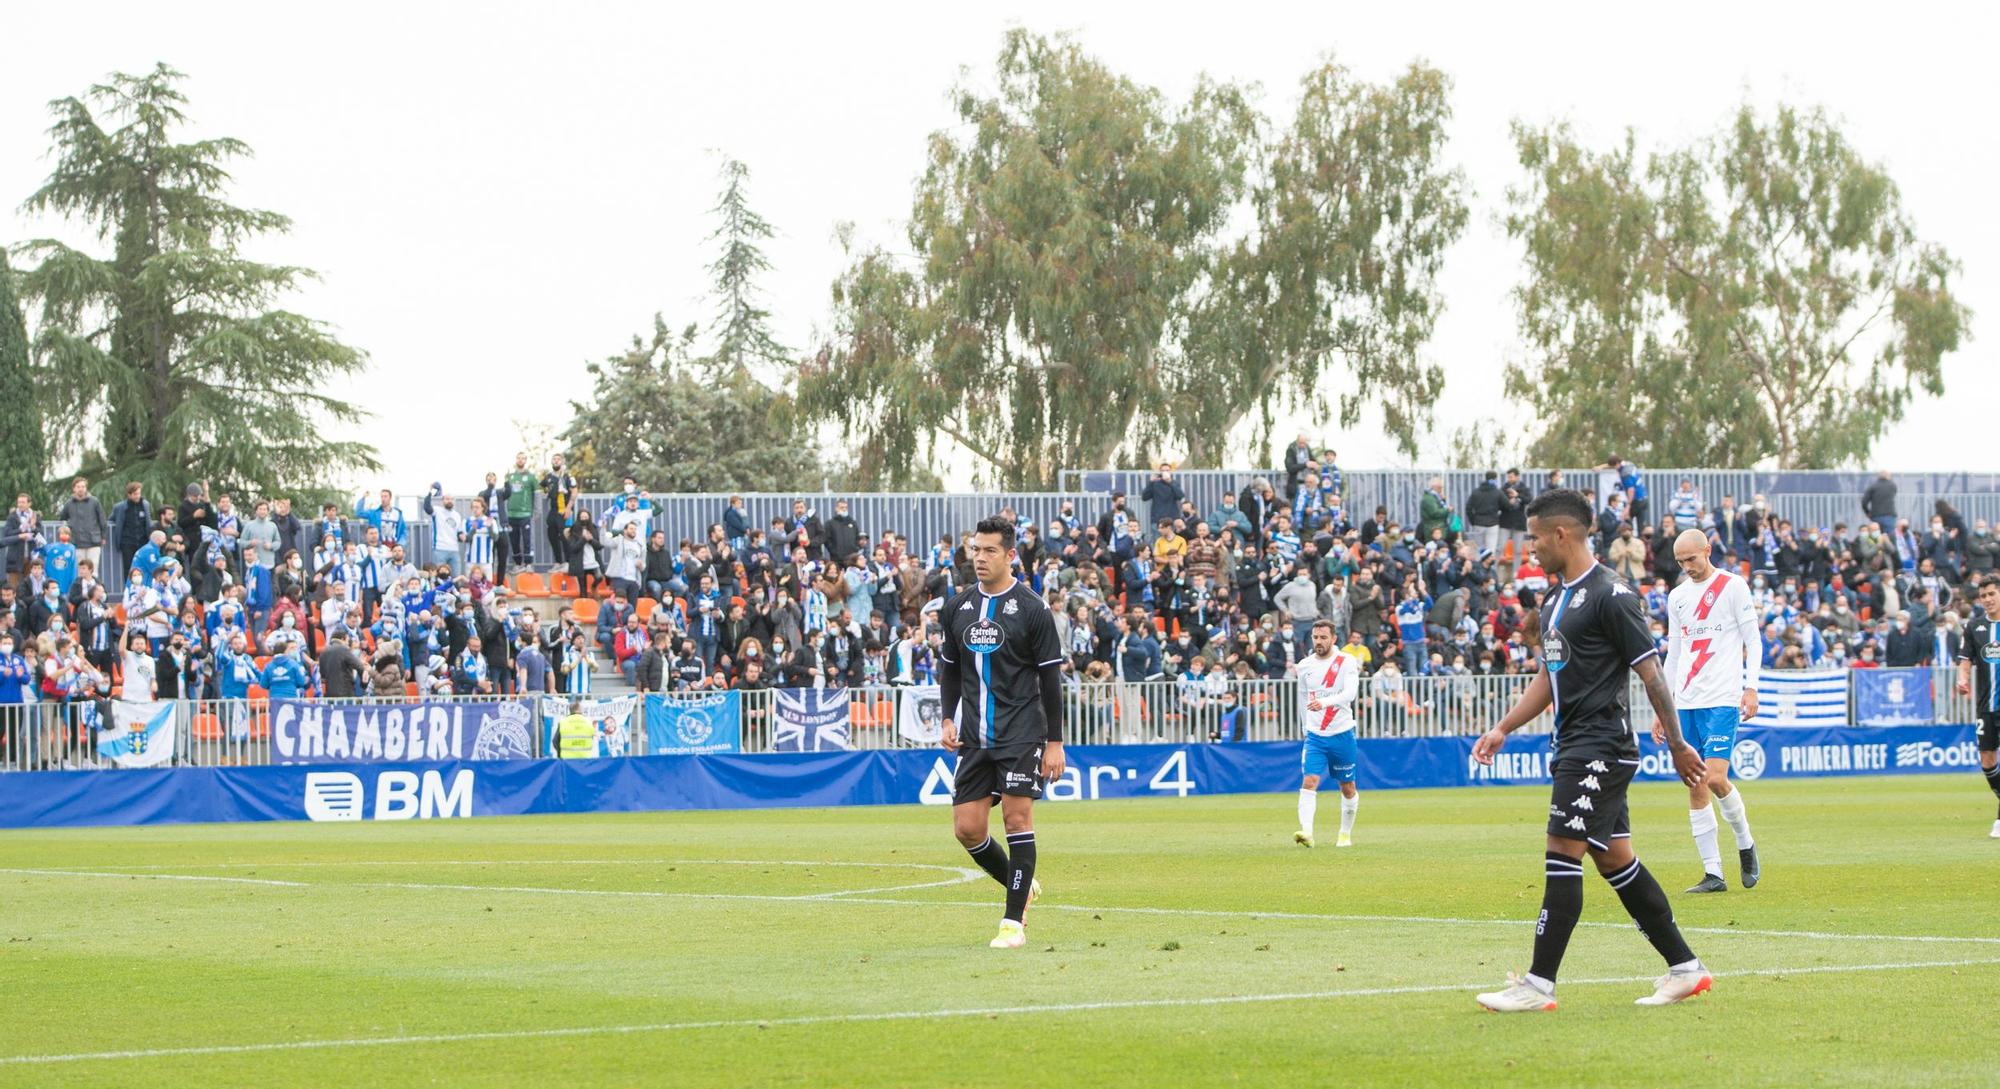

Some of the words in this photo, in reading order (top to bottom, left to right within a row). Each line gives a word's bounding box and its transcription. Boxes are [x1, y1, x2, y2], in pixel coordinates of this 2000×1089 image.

[970, 627, 998, 636] Estrella
[970, 635, 996, 644] Galicia
[662, 695, 726, 708] ARTEIXO
[1781, 744, 1851, 772] PRIMERA
[1854, 743, 1888, 770] RFEF
[374, 769, 475, 820] BM
